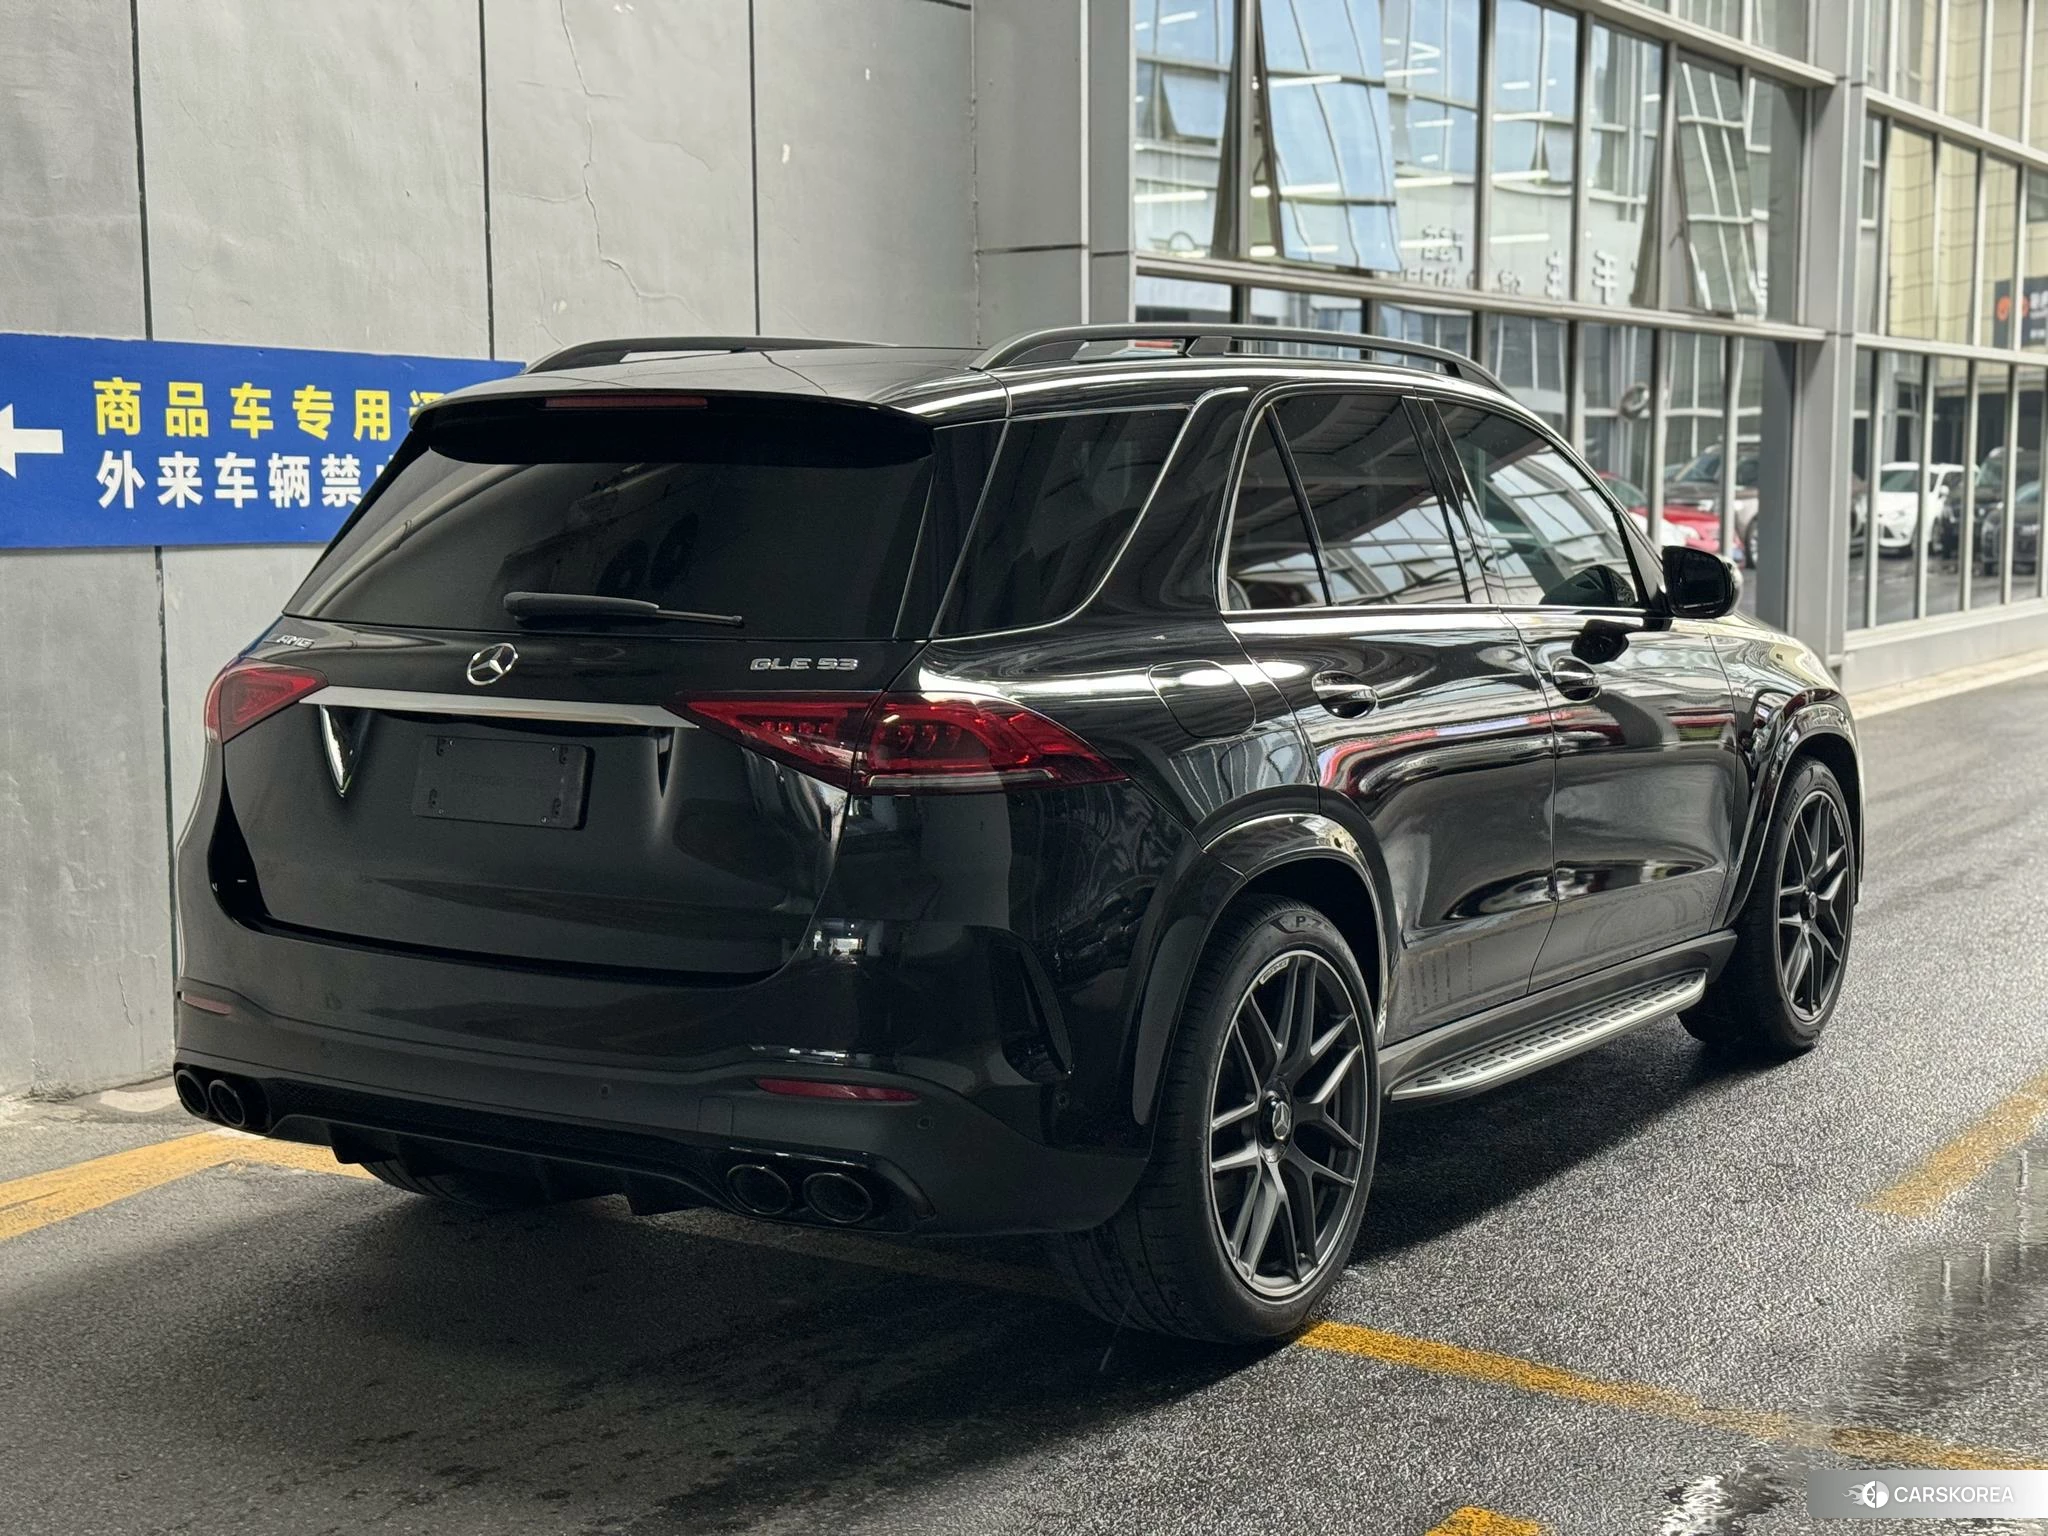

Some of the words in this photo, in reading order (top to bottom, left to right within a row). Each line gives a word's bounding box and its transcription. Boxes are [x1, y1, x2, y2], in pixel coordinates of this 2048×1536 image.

[94, 377, 448, 442] 商品车专用
[96, 450, 394, 509] 外来车辆禁
[277, 635, 314, 648] AMG
[750, 658, 812, 670] GLE
[817, 658, 858, 670] 53
